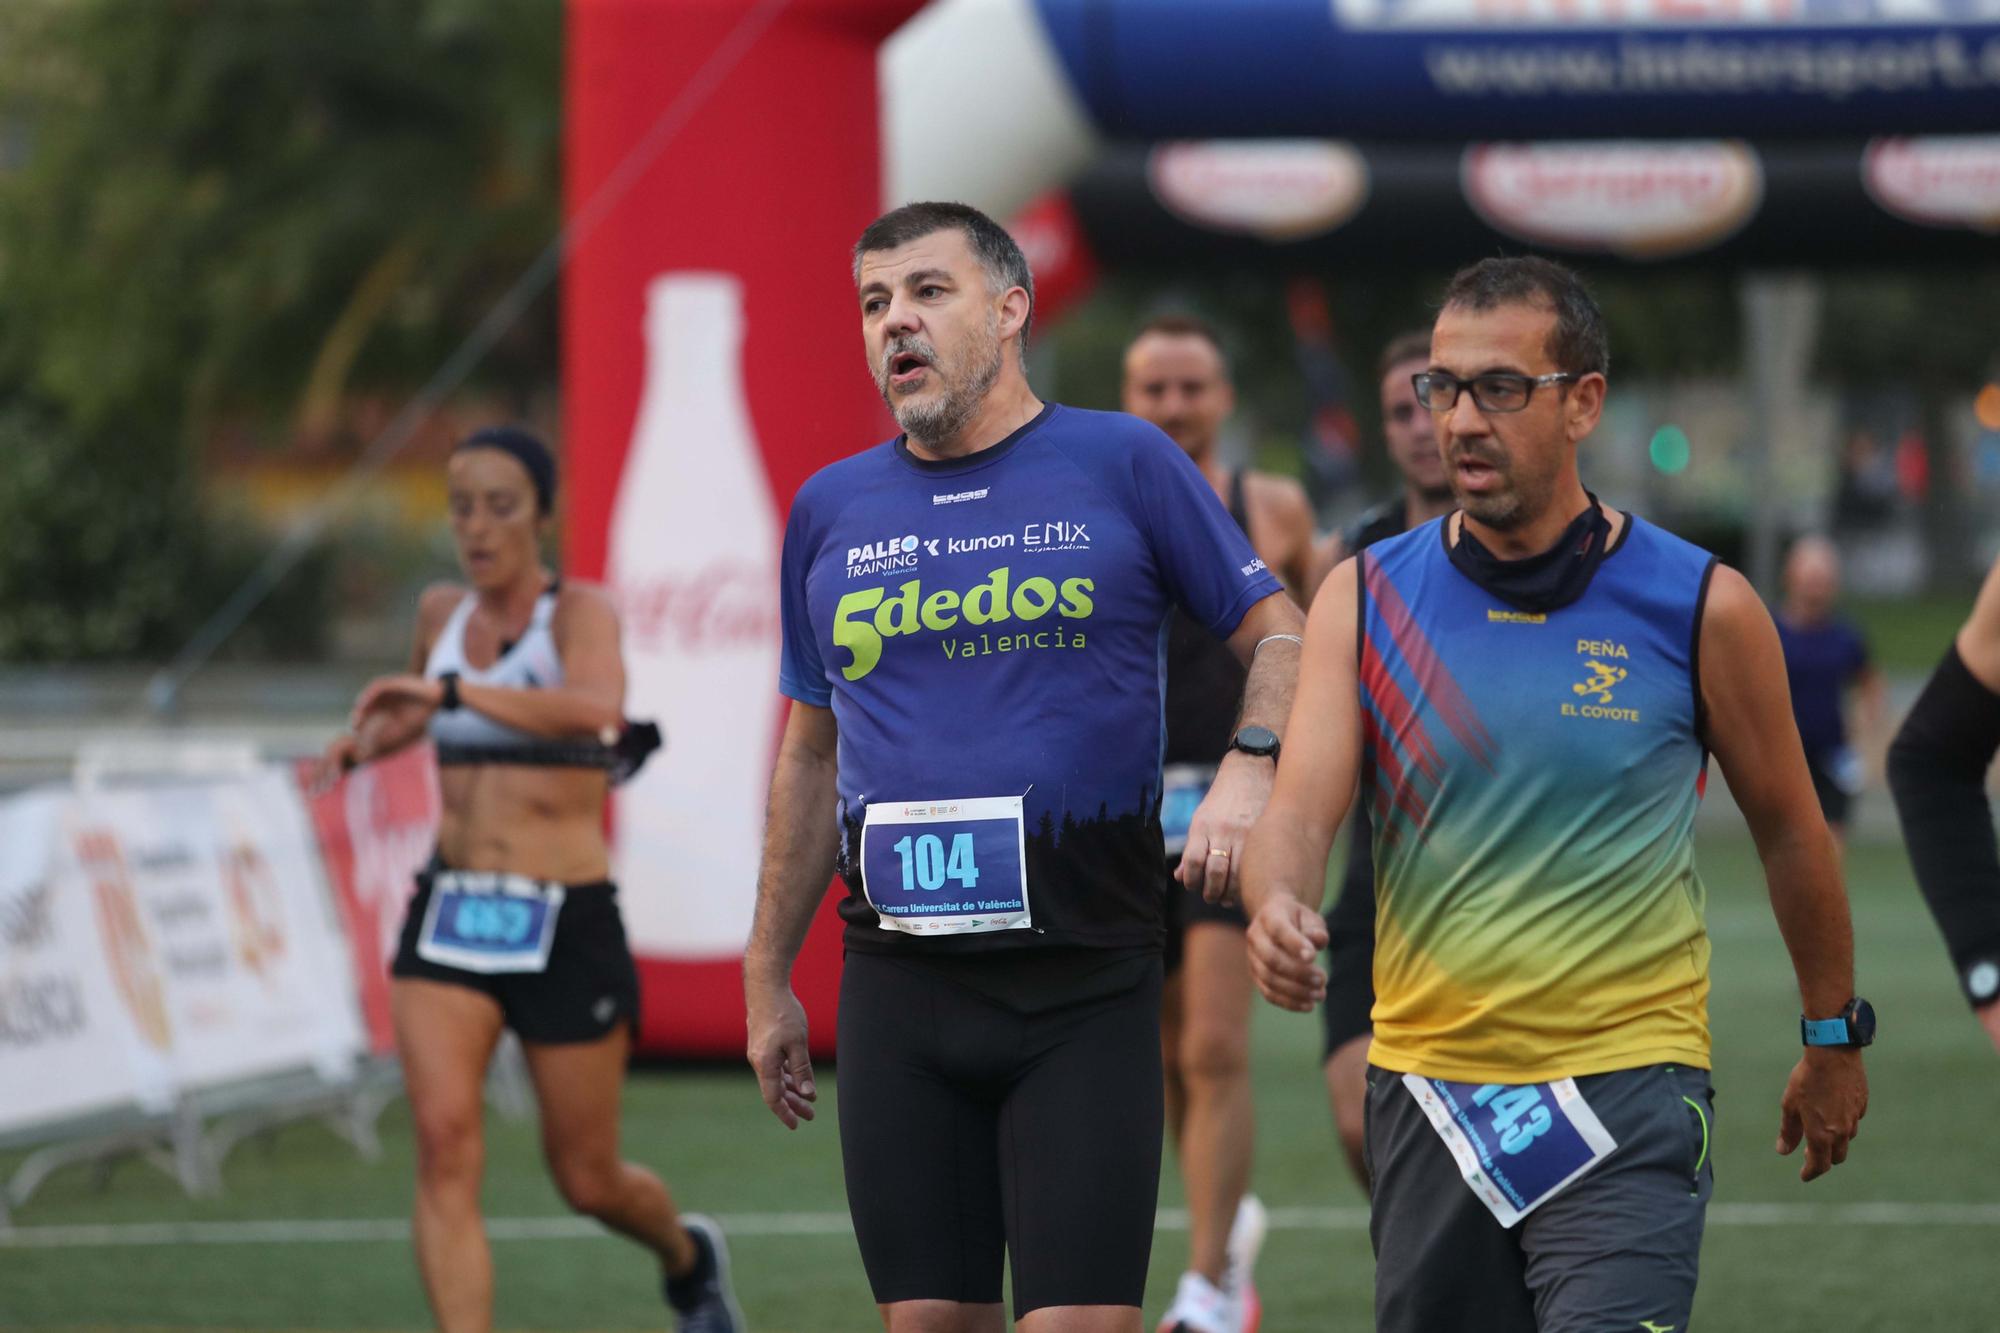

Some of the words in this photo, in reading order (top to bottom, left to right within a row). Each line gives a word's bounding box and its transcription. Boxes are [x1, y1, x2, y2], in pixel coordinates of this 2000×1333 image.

[947, 533, 1015, 554] kunon
[1022, 521, 1091, 545] ENIX
[846, 535, 919, 566] PALEO
[846, 552, 919, 579] TRAINING
[882, 566, 918, 577] Valencia
[832, 567, 1095, 682] 5dedos
[942, 626, 1087, 661] Valencia
[1576, 639, 1629, 659] PEÑA
[1561, 703, 1578, 716] EL
[1581, 706, 1640, 722] COYOTE
[894, 833, 979, 890] 104
[882, 904, 908, 913] Carrera
[910, 902, 960, 913] Universitat
[962, 901, 975, 911] de
[977, 899, 1022, 910] València
